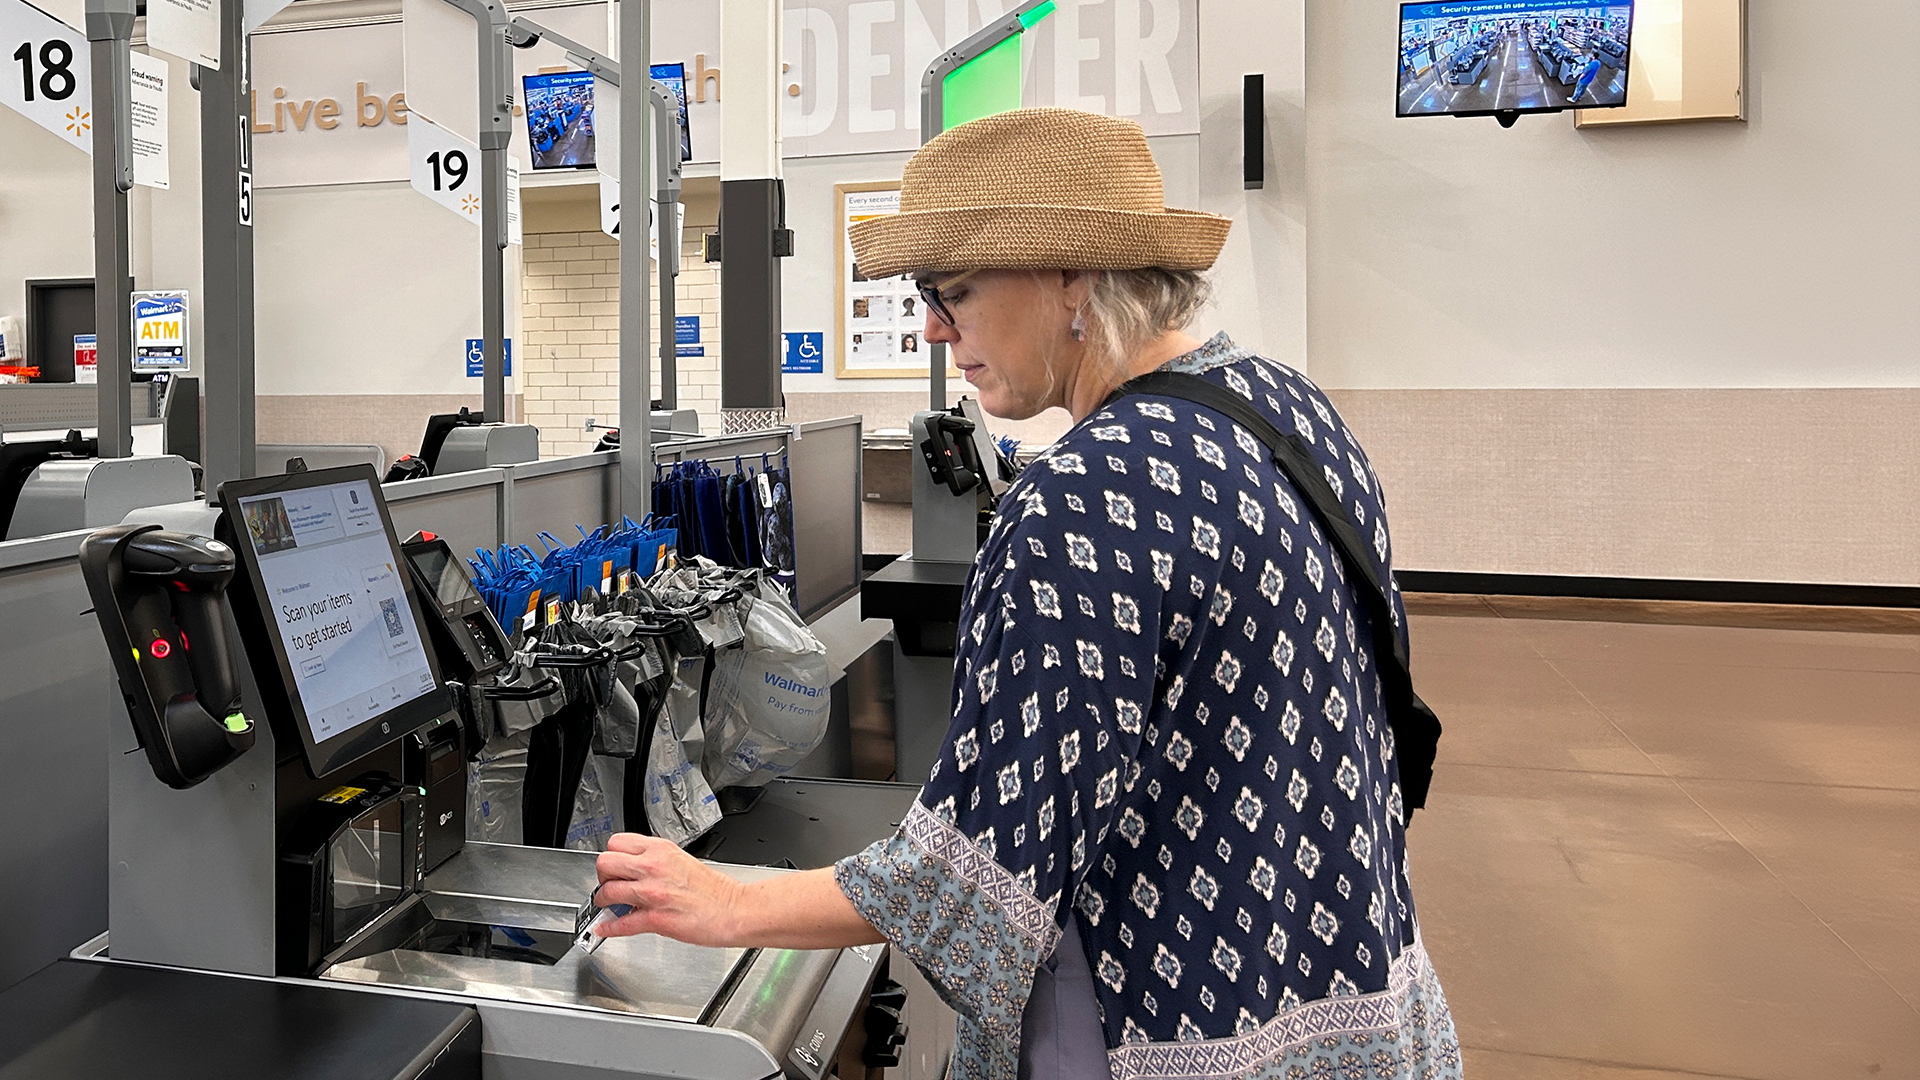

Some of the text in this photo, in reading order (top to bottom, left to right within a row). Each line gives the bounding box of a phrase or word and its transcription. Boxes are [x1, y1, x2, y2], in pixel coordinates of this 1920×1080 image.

[1441, 5, 1471, 14] Security
[1472, 4, 1502, 12] cameras
[13, 39, 76, 102] 18
[131, 67, 164, 87] Fraud warning
[551, 77, 572, 85] Security
[251, 86, 341, 134] Live
[426, 149, 469, 192] 19
[848, 195, 893, 205] Every second
[140, 304, 169, 316] Walmart
[141, 321, 179, 340] ATM
[152, 374, 169, 383] ATM
[282, 593, 353, 623] Scan your items
[291, 615, 353, 651] to get started
[767, 696, 787, 712] Pay
[788, 703, 814, 717] from
[809, 1029, 826, 1052] COINS
